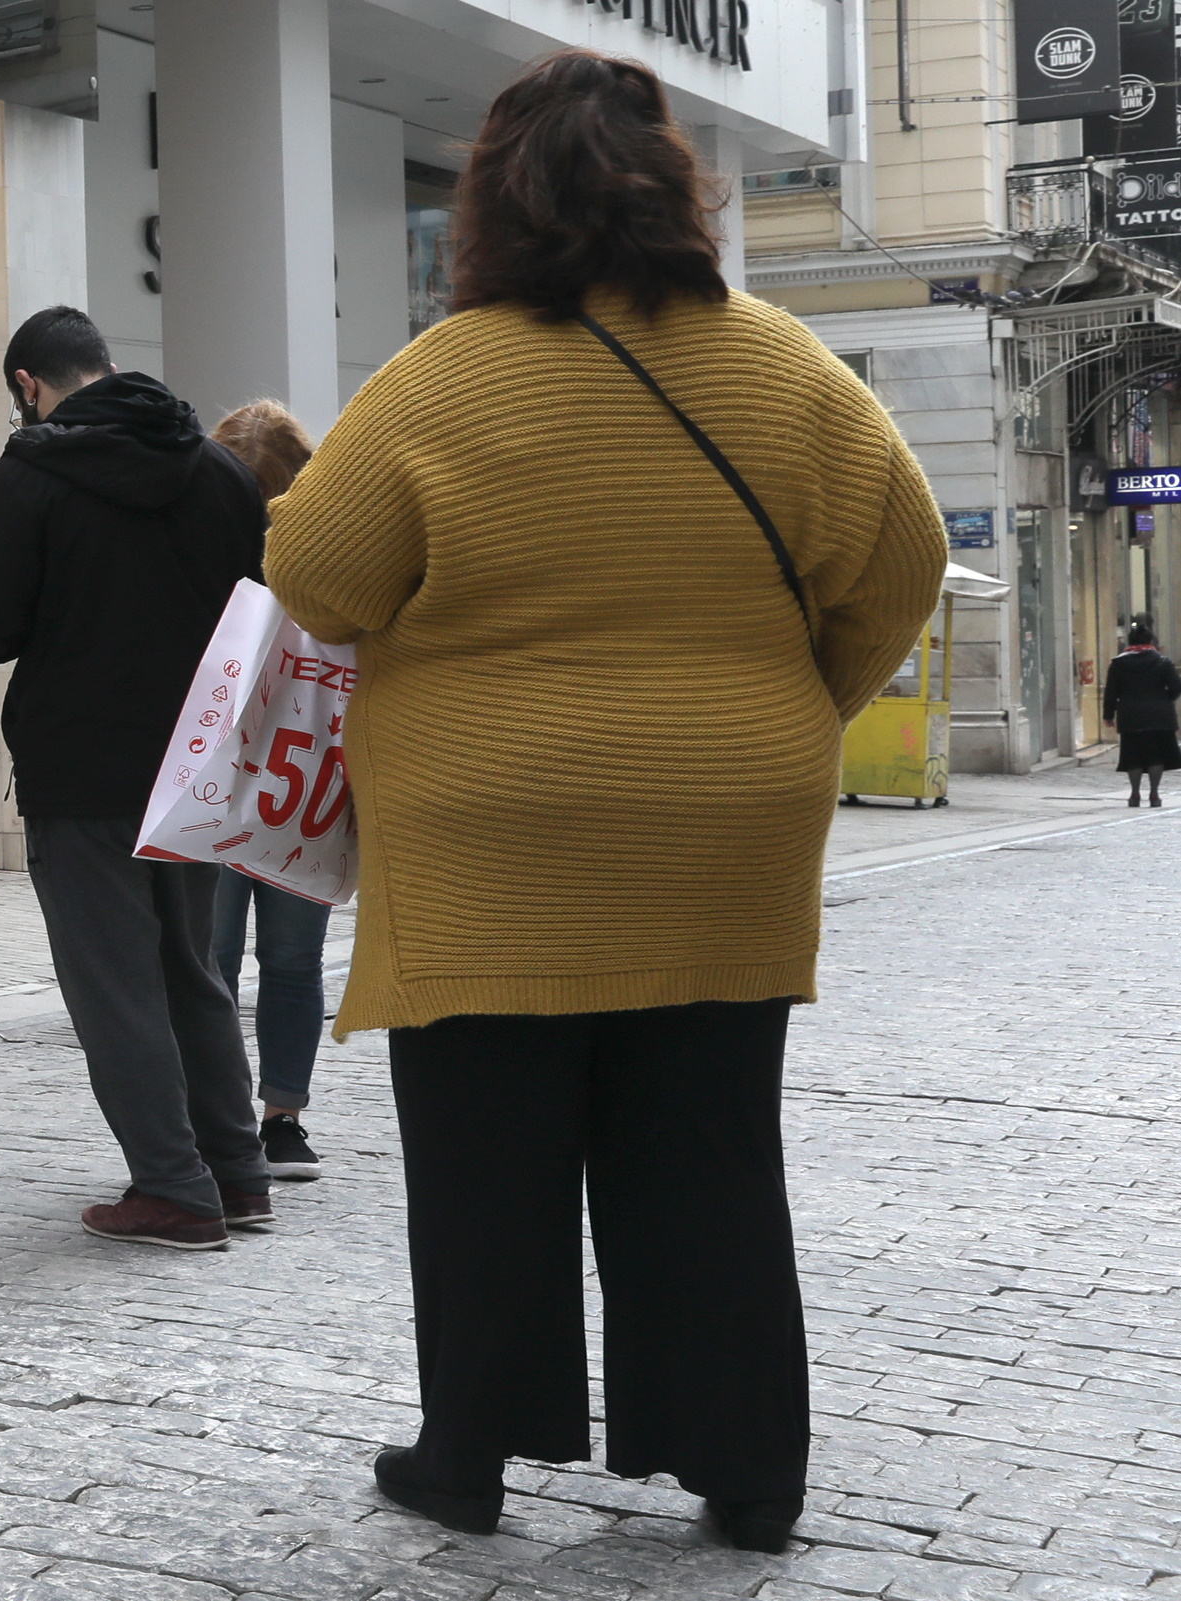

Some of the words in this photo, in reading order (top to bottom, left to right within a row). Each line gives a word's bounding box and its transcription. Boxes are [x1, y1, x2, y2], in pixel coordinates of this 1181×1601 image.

[1049, 39, 1081, 55] SLAM
[1049, 51, 1082, 67] DUNK
[1120, 87, 1143, 98] LAM
[1121, 96, 1143, 109] UNK
[1117, 473, 1180, 490] BERTO
[243, 727, 358, 841] -50
